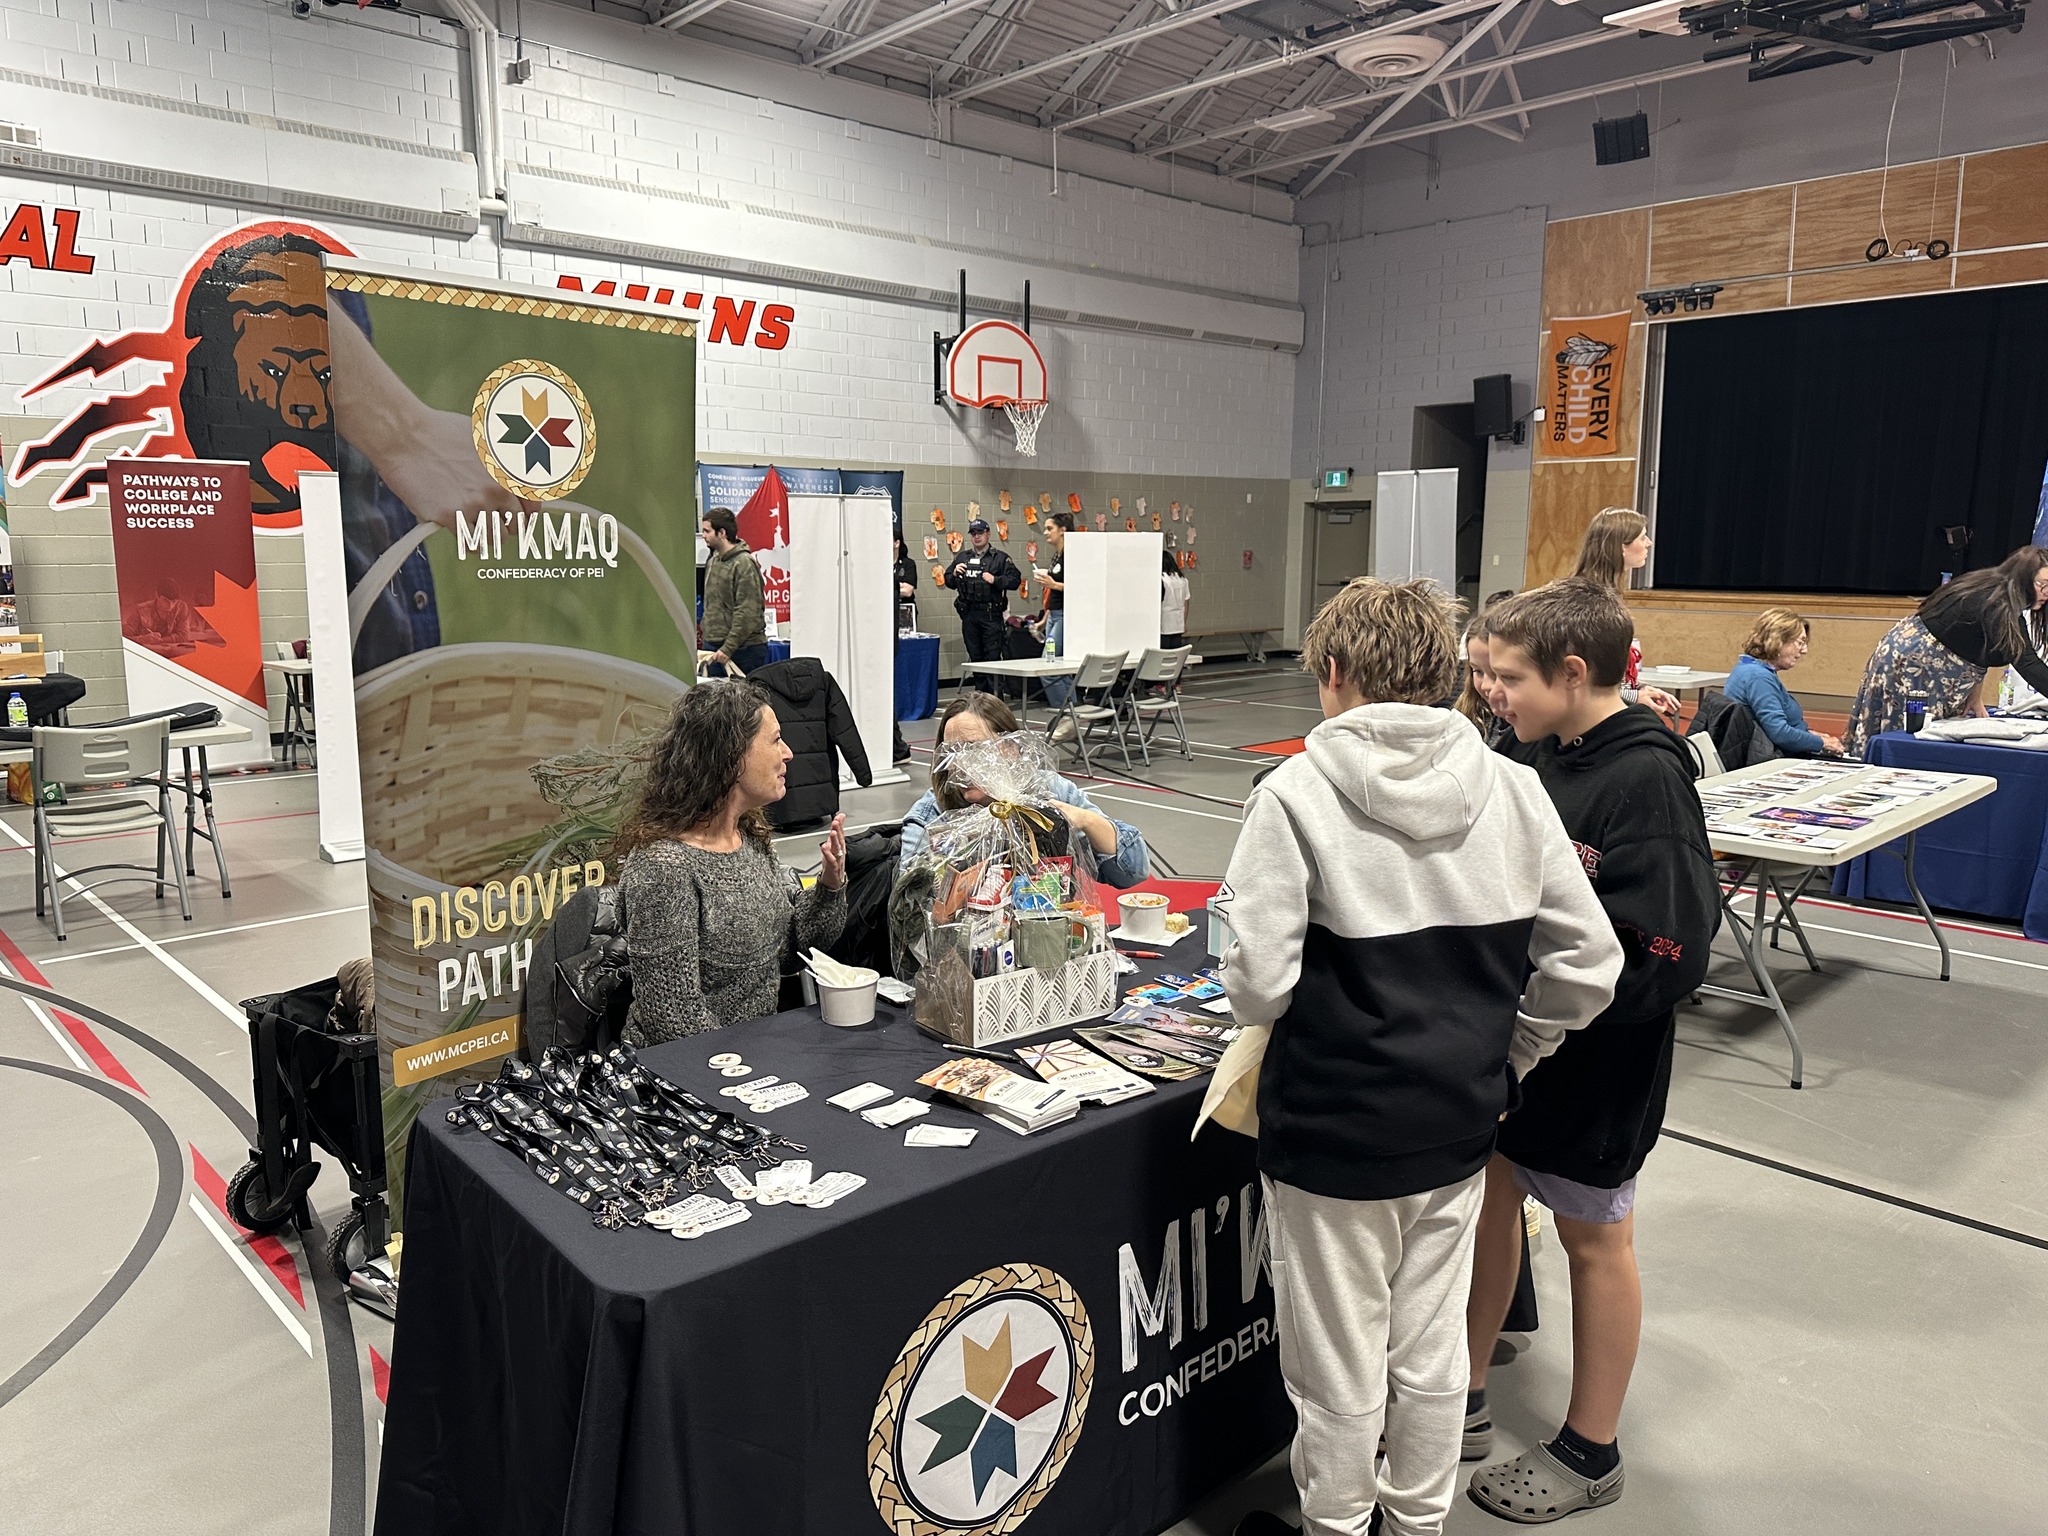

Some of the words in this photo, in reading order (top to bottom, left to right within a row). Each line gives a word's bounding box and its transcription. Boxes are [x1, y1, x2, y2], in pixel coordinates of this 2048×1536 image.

[1553, 365, 1569, 442] MATTERS
[1567, 366, 1592, 444] CHILD
[1589, 363, 1612, 441] EVERY
[122, 474, 200, 489] PATHWAYS
[203, 476, 222, 489] TO
[123, 488, 189, 502] COLLEGE
[191, 489, 222, 502] AND
[709, 496, 750, 505] SENSIBILIS
[125, 503, 215, 516] WORKPLACE
[126, 517, 195, 529] SUCCESS
[455, 510, 619, 568] MI'KMAQ
[477, 567, 567, 580] CONFEDERACY
[569, 567, 585, 579] OF
[587, 567, 605, 579] PEI
[411, 860, 606, 949] DISCOVER
[406, 1029, 510, 1072] WWW.MCPEI.CA
[1118, 1182, 1275, 1374] MI'K
[1118, 1317, 1280, 1426] CONFEDER
